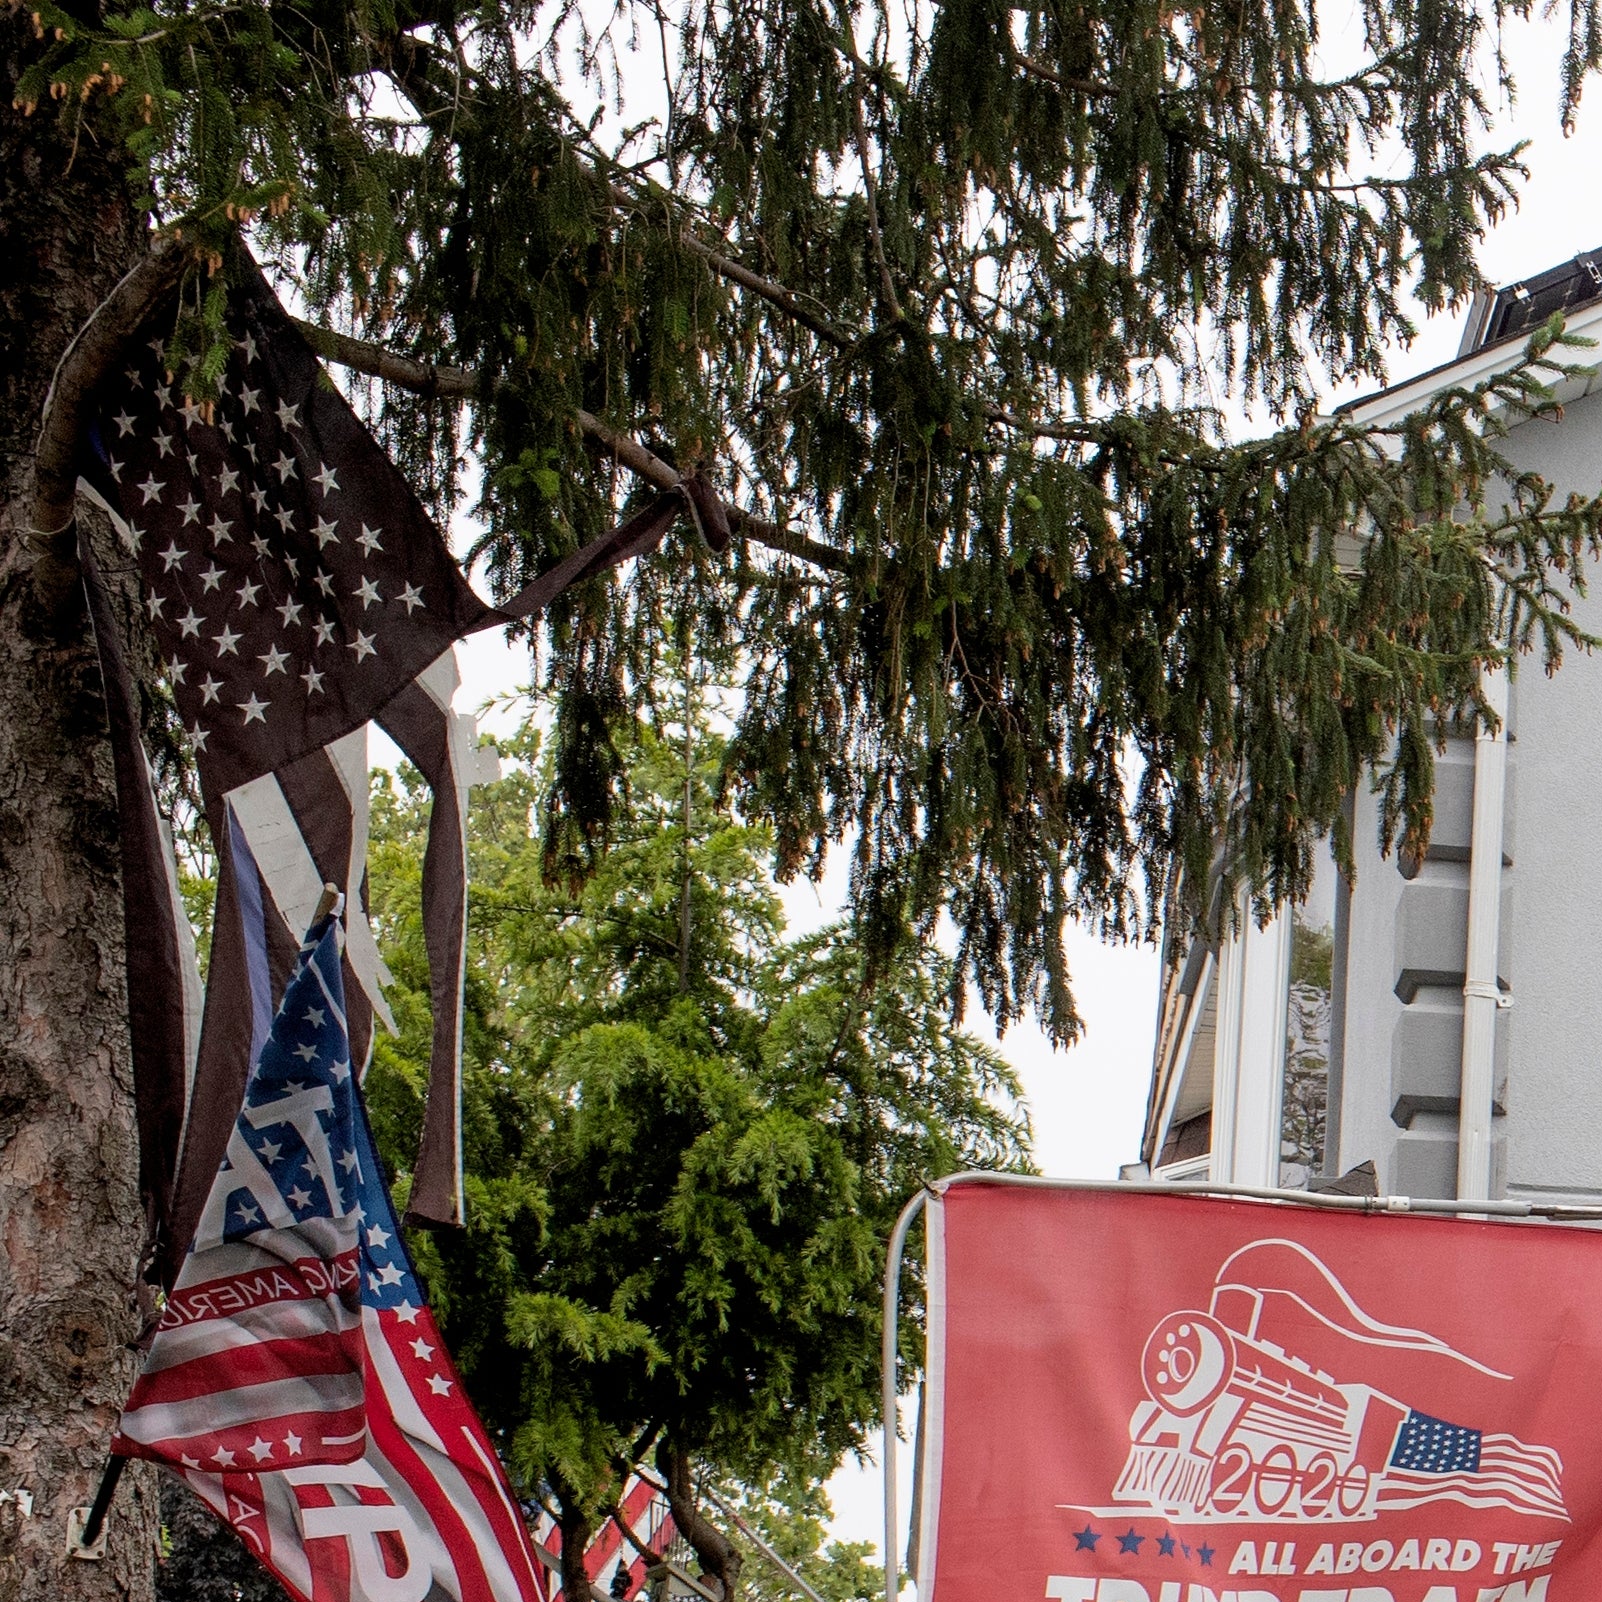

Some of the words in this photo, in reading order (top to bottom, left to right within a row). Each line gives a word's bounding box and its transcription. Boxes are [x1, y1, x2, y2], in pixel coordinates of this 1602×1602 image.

[1210, 1445, 1372, 1517] 2020
[1228, 1540, 1297, 1576] ALL
[1303, 1538, 1482, 1576] ABOARD
[1491, 1538, 1563, 1575] THE
